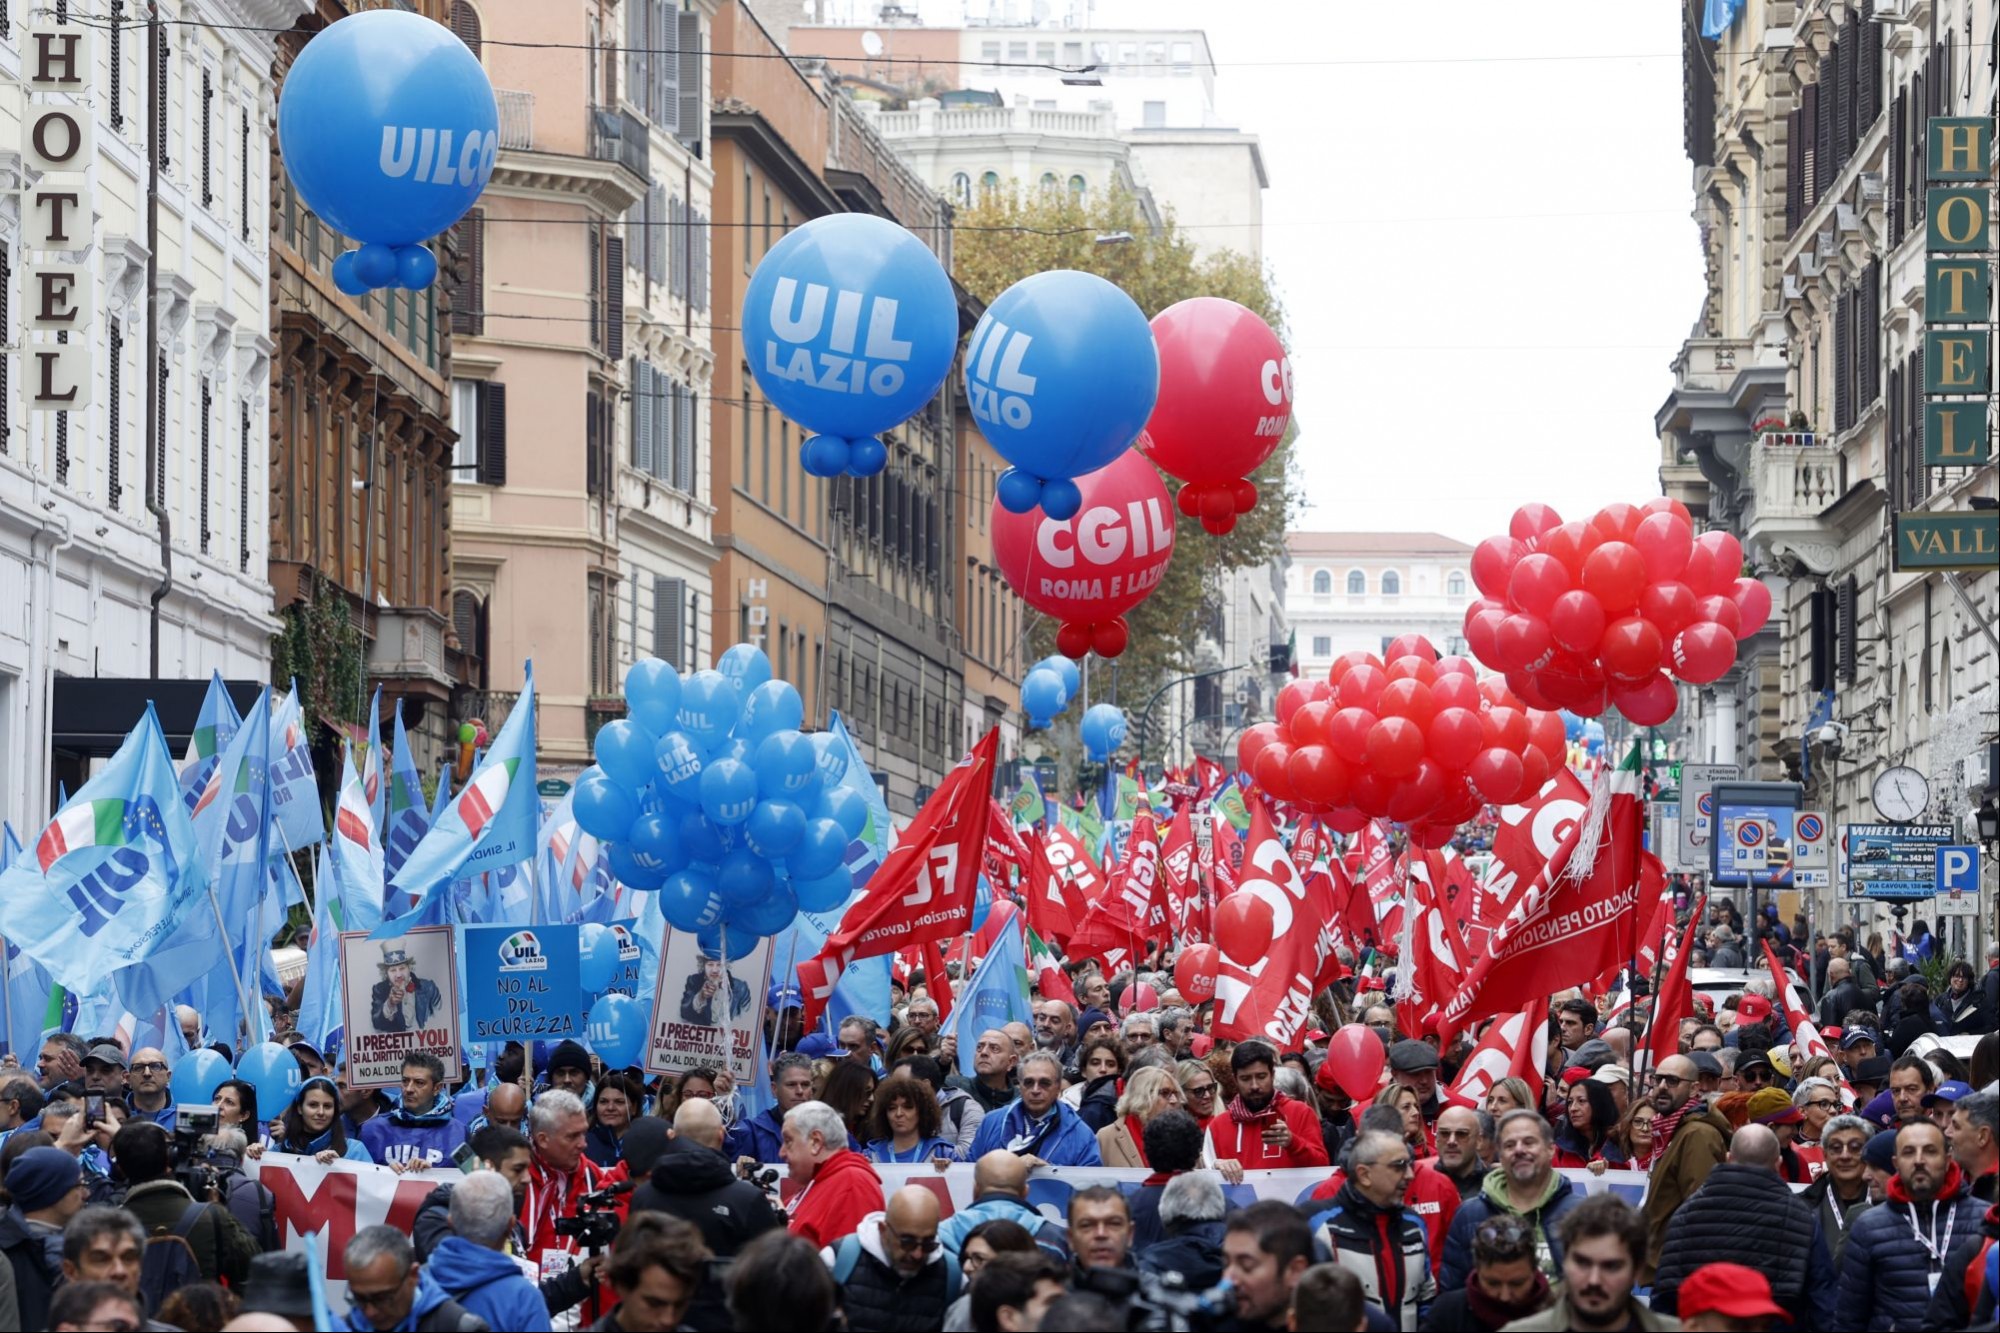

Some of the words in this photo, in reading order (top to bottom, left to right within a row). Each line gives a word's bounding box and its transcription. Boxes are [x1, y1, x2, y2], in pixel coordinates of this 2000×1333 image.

[30, 33, 82, 403] HOTEL
[1936, 126, 1983, 457] HOTEL
[769, 276, 913, 361] UIL
[766, 340, 905, 397] LAZIO
[1037, 497, 1171, 569] CGIL
[1906, 527, 1999, 555] VALL
[1040, 578, 1104, 601] ROMA
[1110, 576, 1123, 598] E
[665, 759, 702, 785] LAZIO
[1706, 774, 1737, 782] Termini
[1851, 826, 1952, 837] WHEEL.TOURS
[1943, 850, 1970, 887] P
[514, 947, 538, 958] UIL
[497, 977, 521, 995] NO
[528, 976, 551, 993] AL
[508, 997, 541, 1015] DDL
[477, 1014, 573, 1037] SICUREZZA
[661, 1022, 666, 1037] I
[667, 1023, 718, 1044] PRECETT
[356, 1036, 361, 1051] I
[363, 1032, 414, 1051] PRECETT
[415, 1028, 449, 1047] YOU
[654, 1038, 662, 1049] SI
[662, 1039, 672, 1050] AL
[673, 1040, 704, 1054] DIRITTO
[704, 1043, 713, 1055] DI
[353, 1053, 361, 1064] SI
[361, 1052, 372, 1063] AL
[373, 1050, 404, 1063] DIRITTO
[659, 1053, 671, 1064] NO
[672, 1054, 683, 1065] AL
[683, 1055, 699, 1067] DDL
[360, 1066, 371, 1077] NO
[372, 1065, 383, 1076] AL
[385, 1064, 400, 1075] DDL
